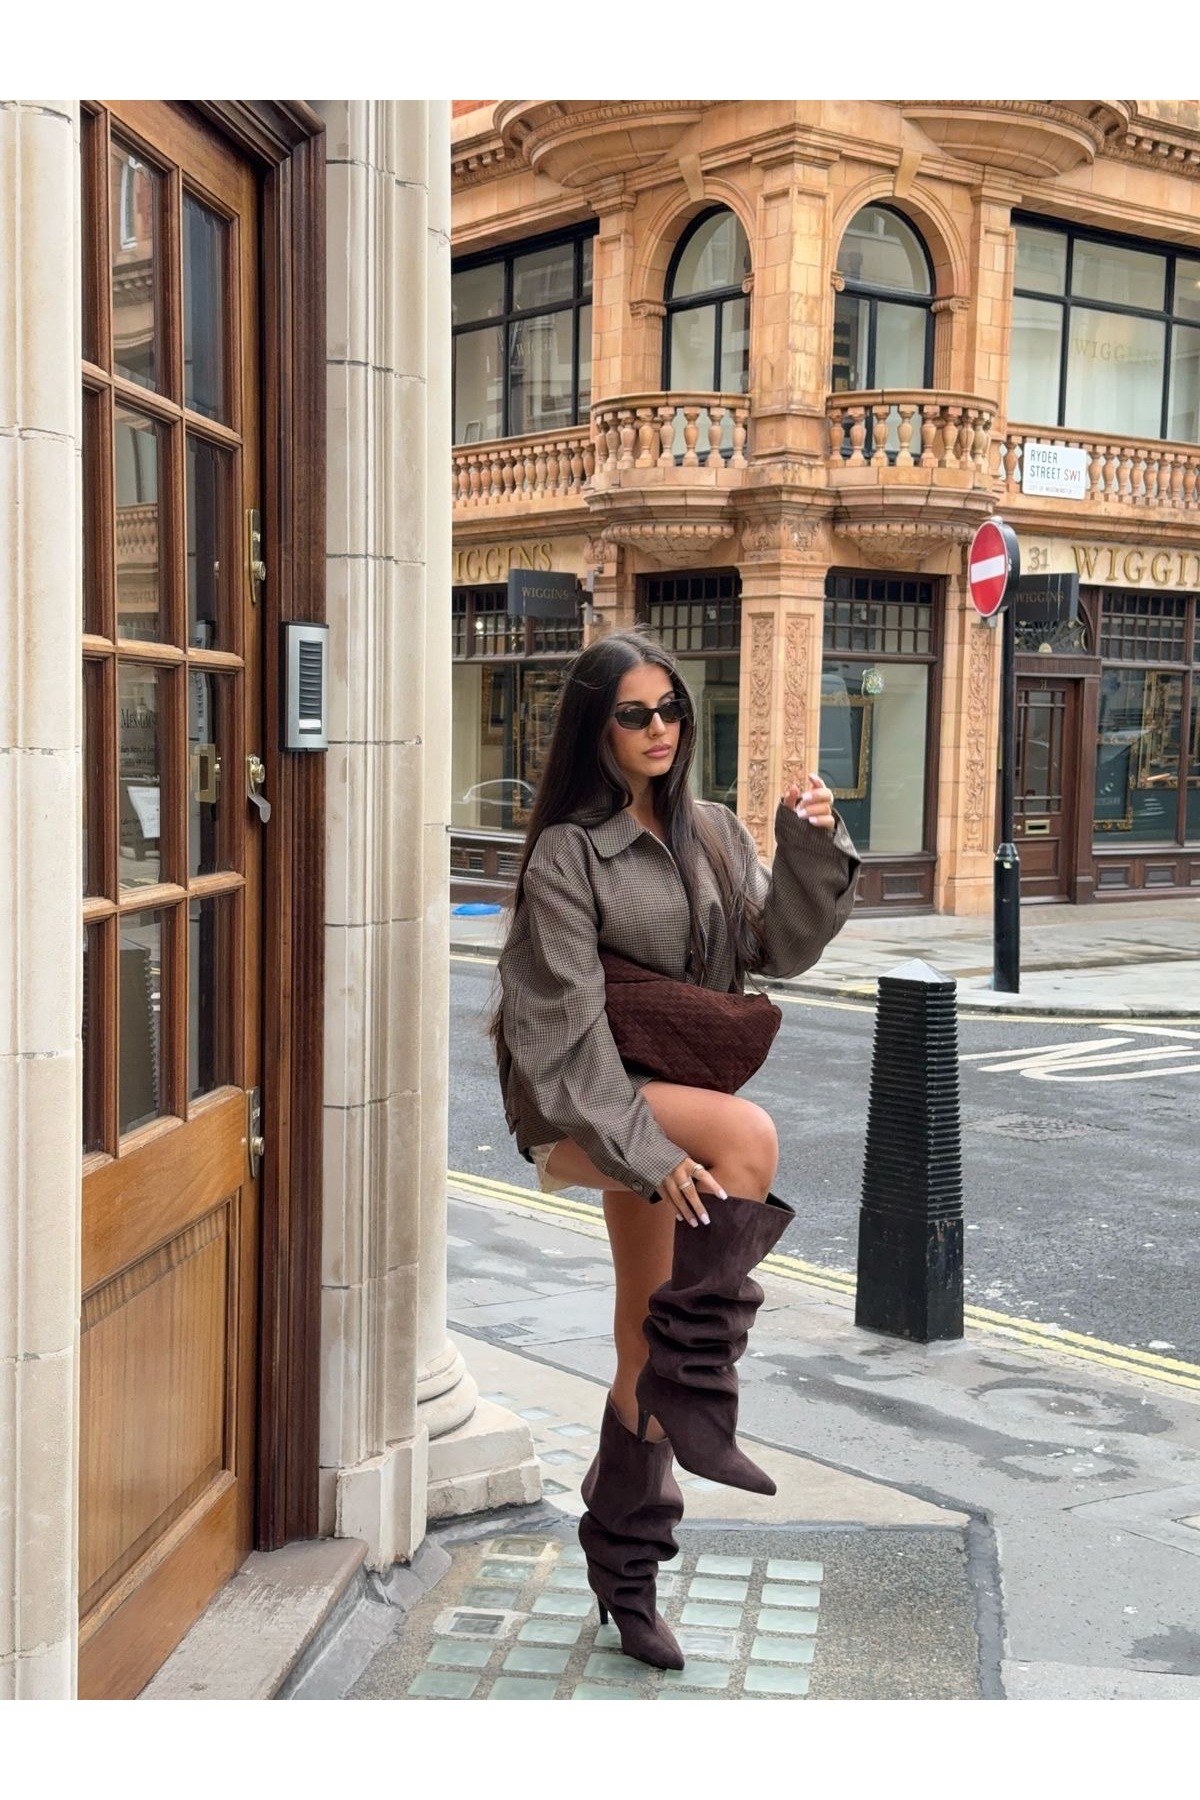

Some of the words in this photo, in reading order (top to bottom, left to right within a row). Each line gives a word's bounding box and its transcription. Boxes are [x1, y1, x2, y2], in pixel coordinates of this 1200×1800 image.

[1030, 449, 1058, 465] RYDER
[1030, 465, 1061, 480] STREET
[1063, 468, 1081, 482] SW1
[1027, 546, 1050, 572] 31
[1070, 543, 1200, 588] WIGGI
[521, 587, 570, 601] WIGGINS
[1015, 590, 1065, 604] WIGGINS
